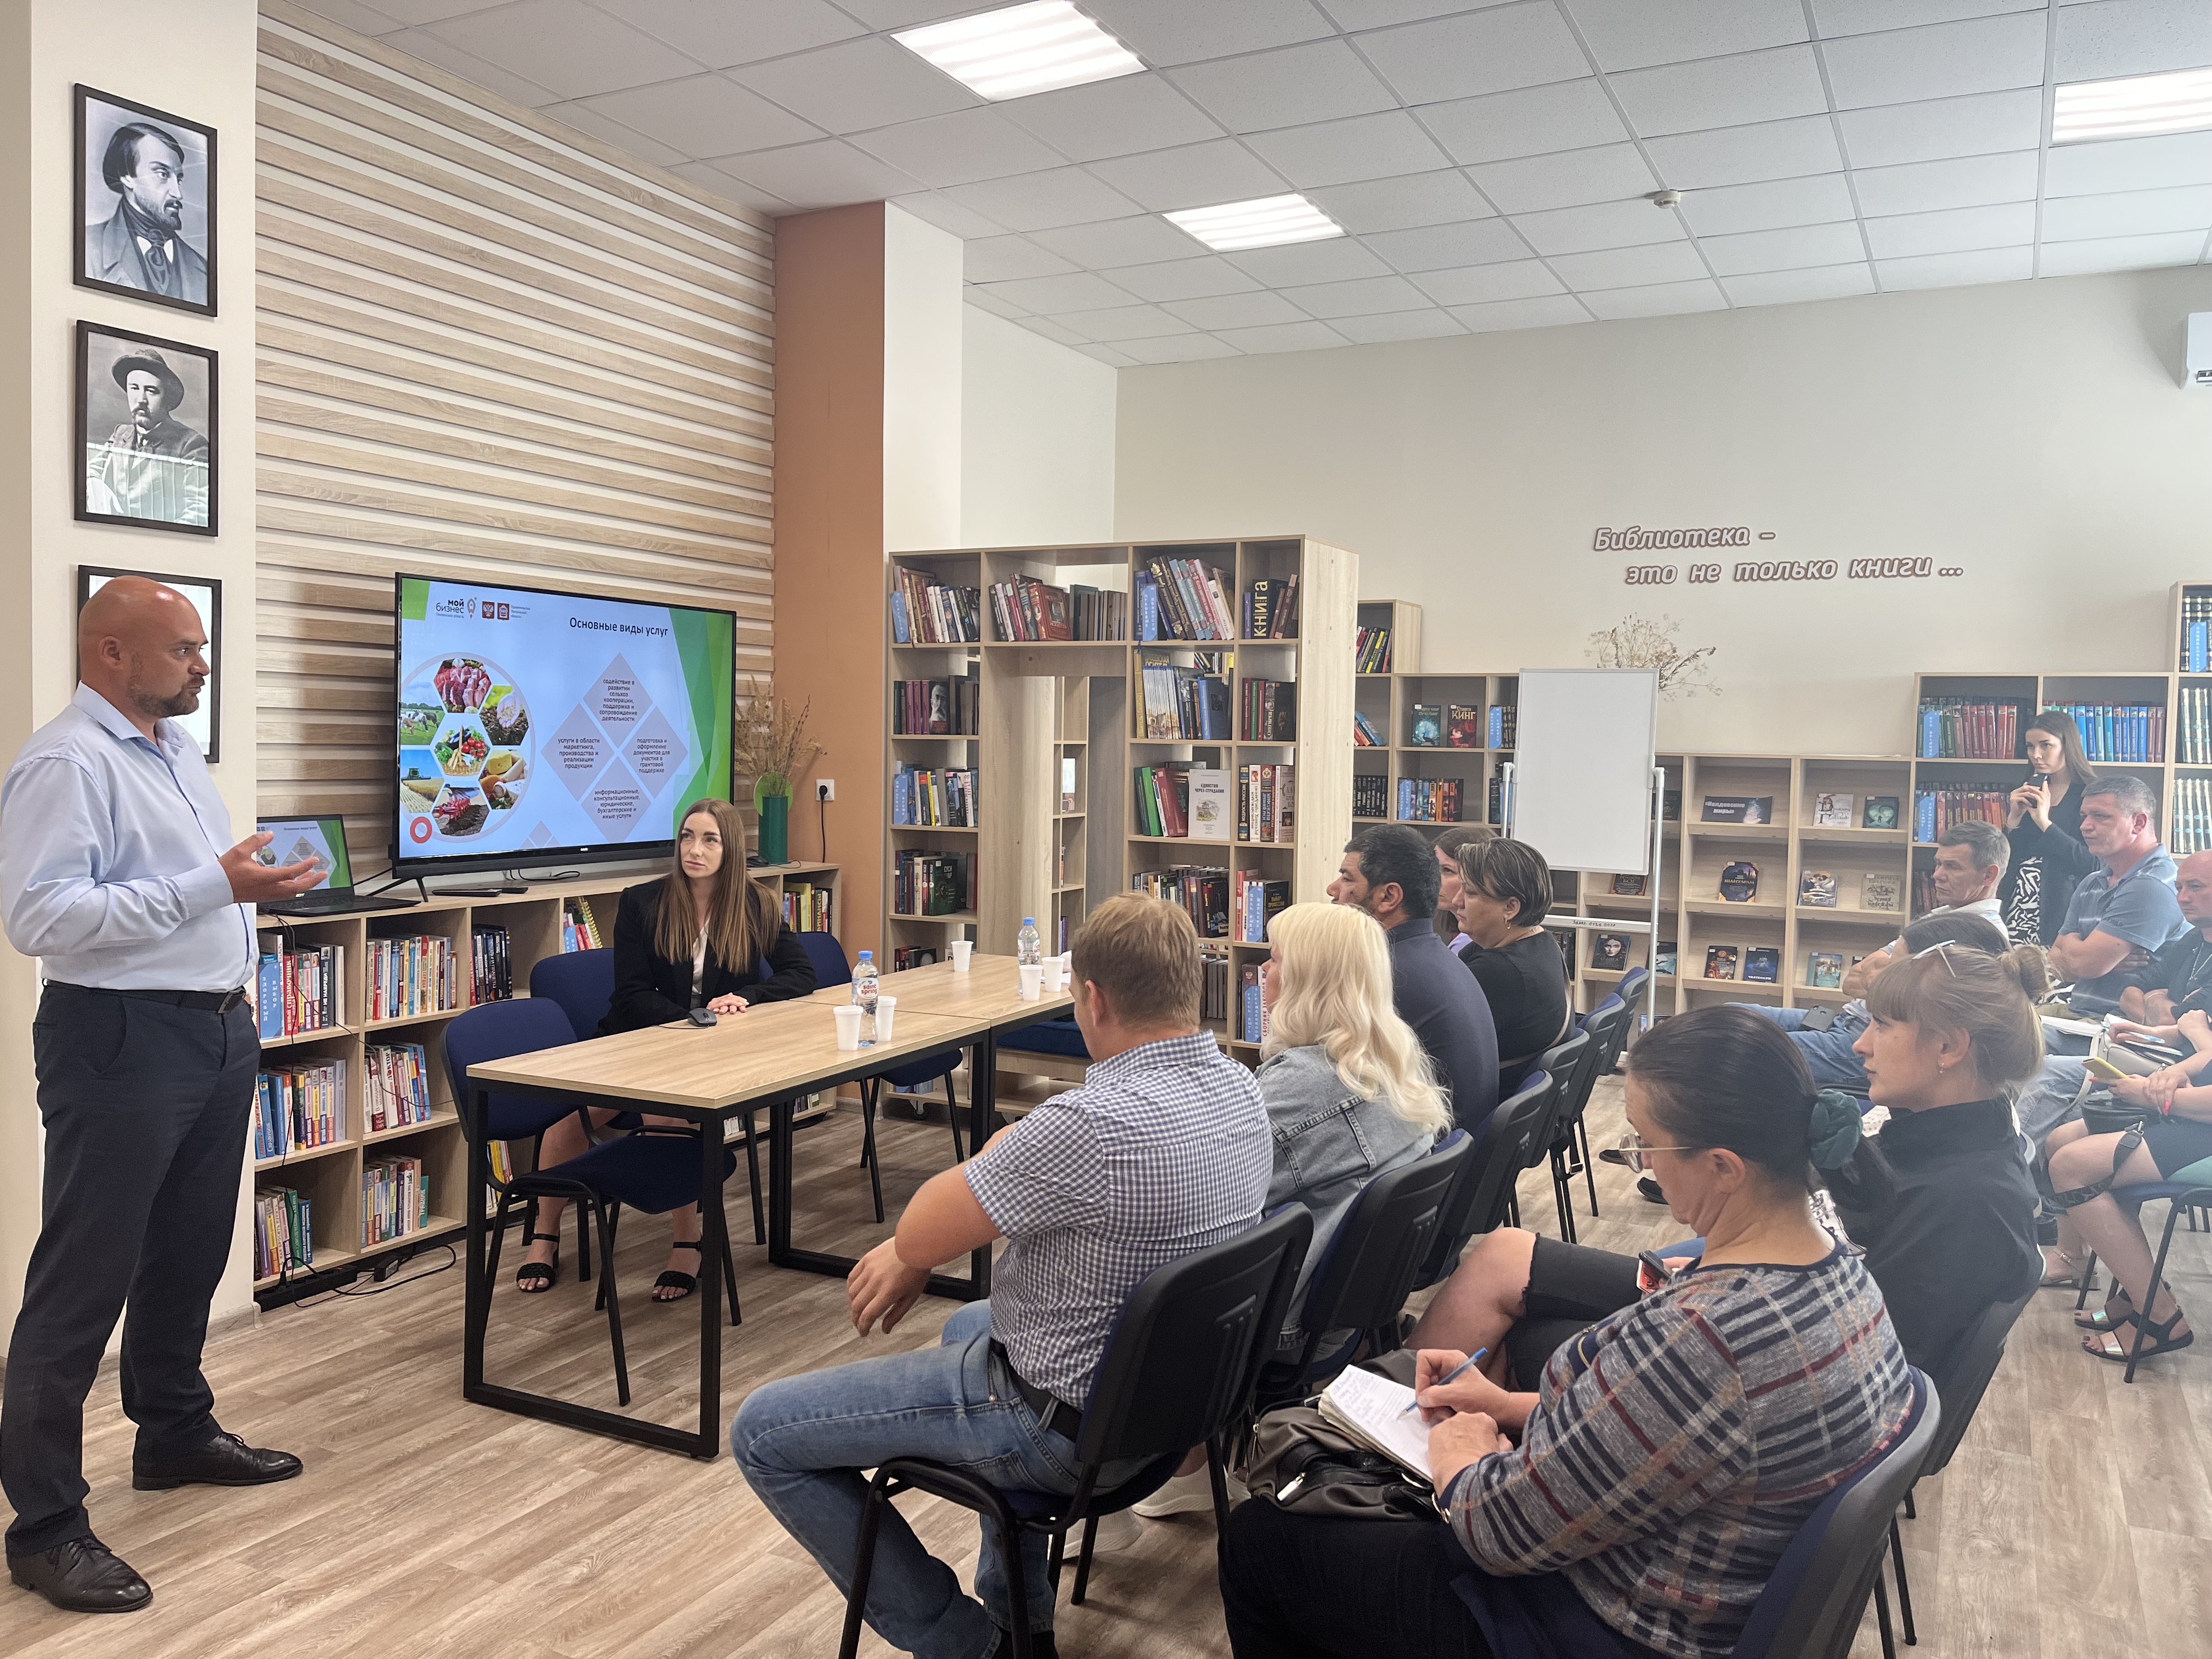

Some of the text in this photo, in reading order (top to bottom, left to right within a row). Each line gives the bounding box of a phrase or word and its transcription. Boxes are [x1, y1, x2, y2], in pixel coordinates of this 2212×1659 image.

[1594, 525, 1751, 550] Библиотека
[1624, 563, 1678, 585] это
[1689, 562, 1722, 583] не
[1734, 558, 1838, 582] только
[1848, 556, 1933, 579] книги
[436, 602, 465, 614] бизнес
[448, 599, 464, 607] мой
[569, 617, 668, 637] Основные виды услуг
[1452, 710, 1476, 720] КИНГ
